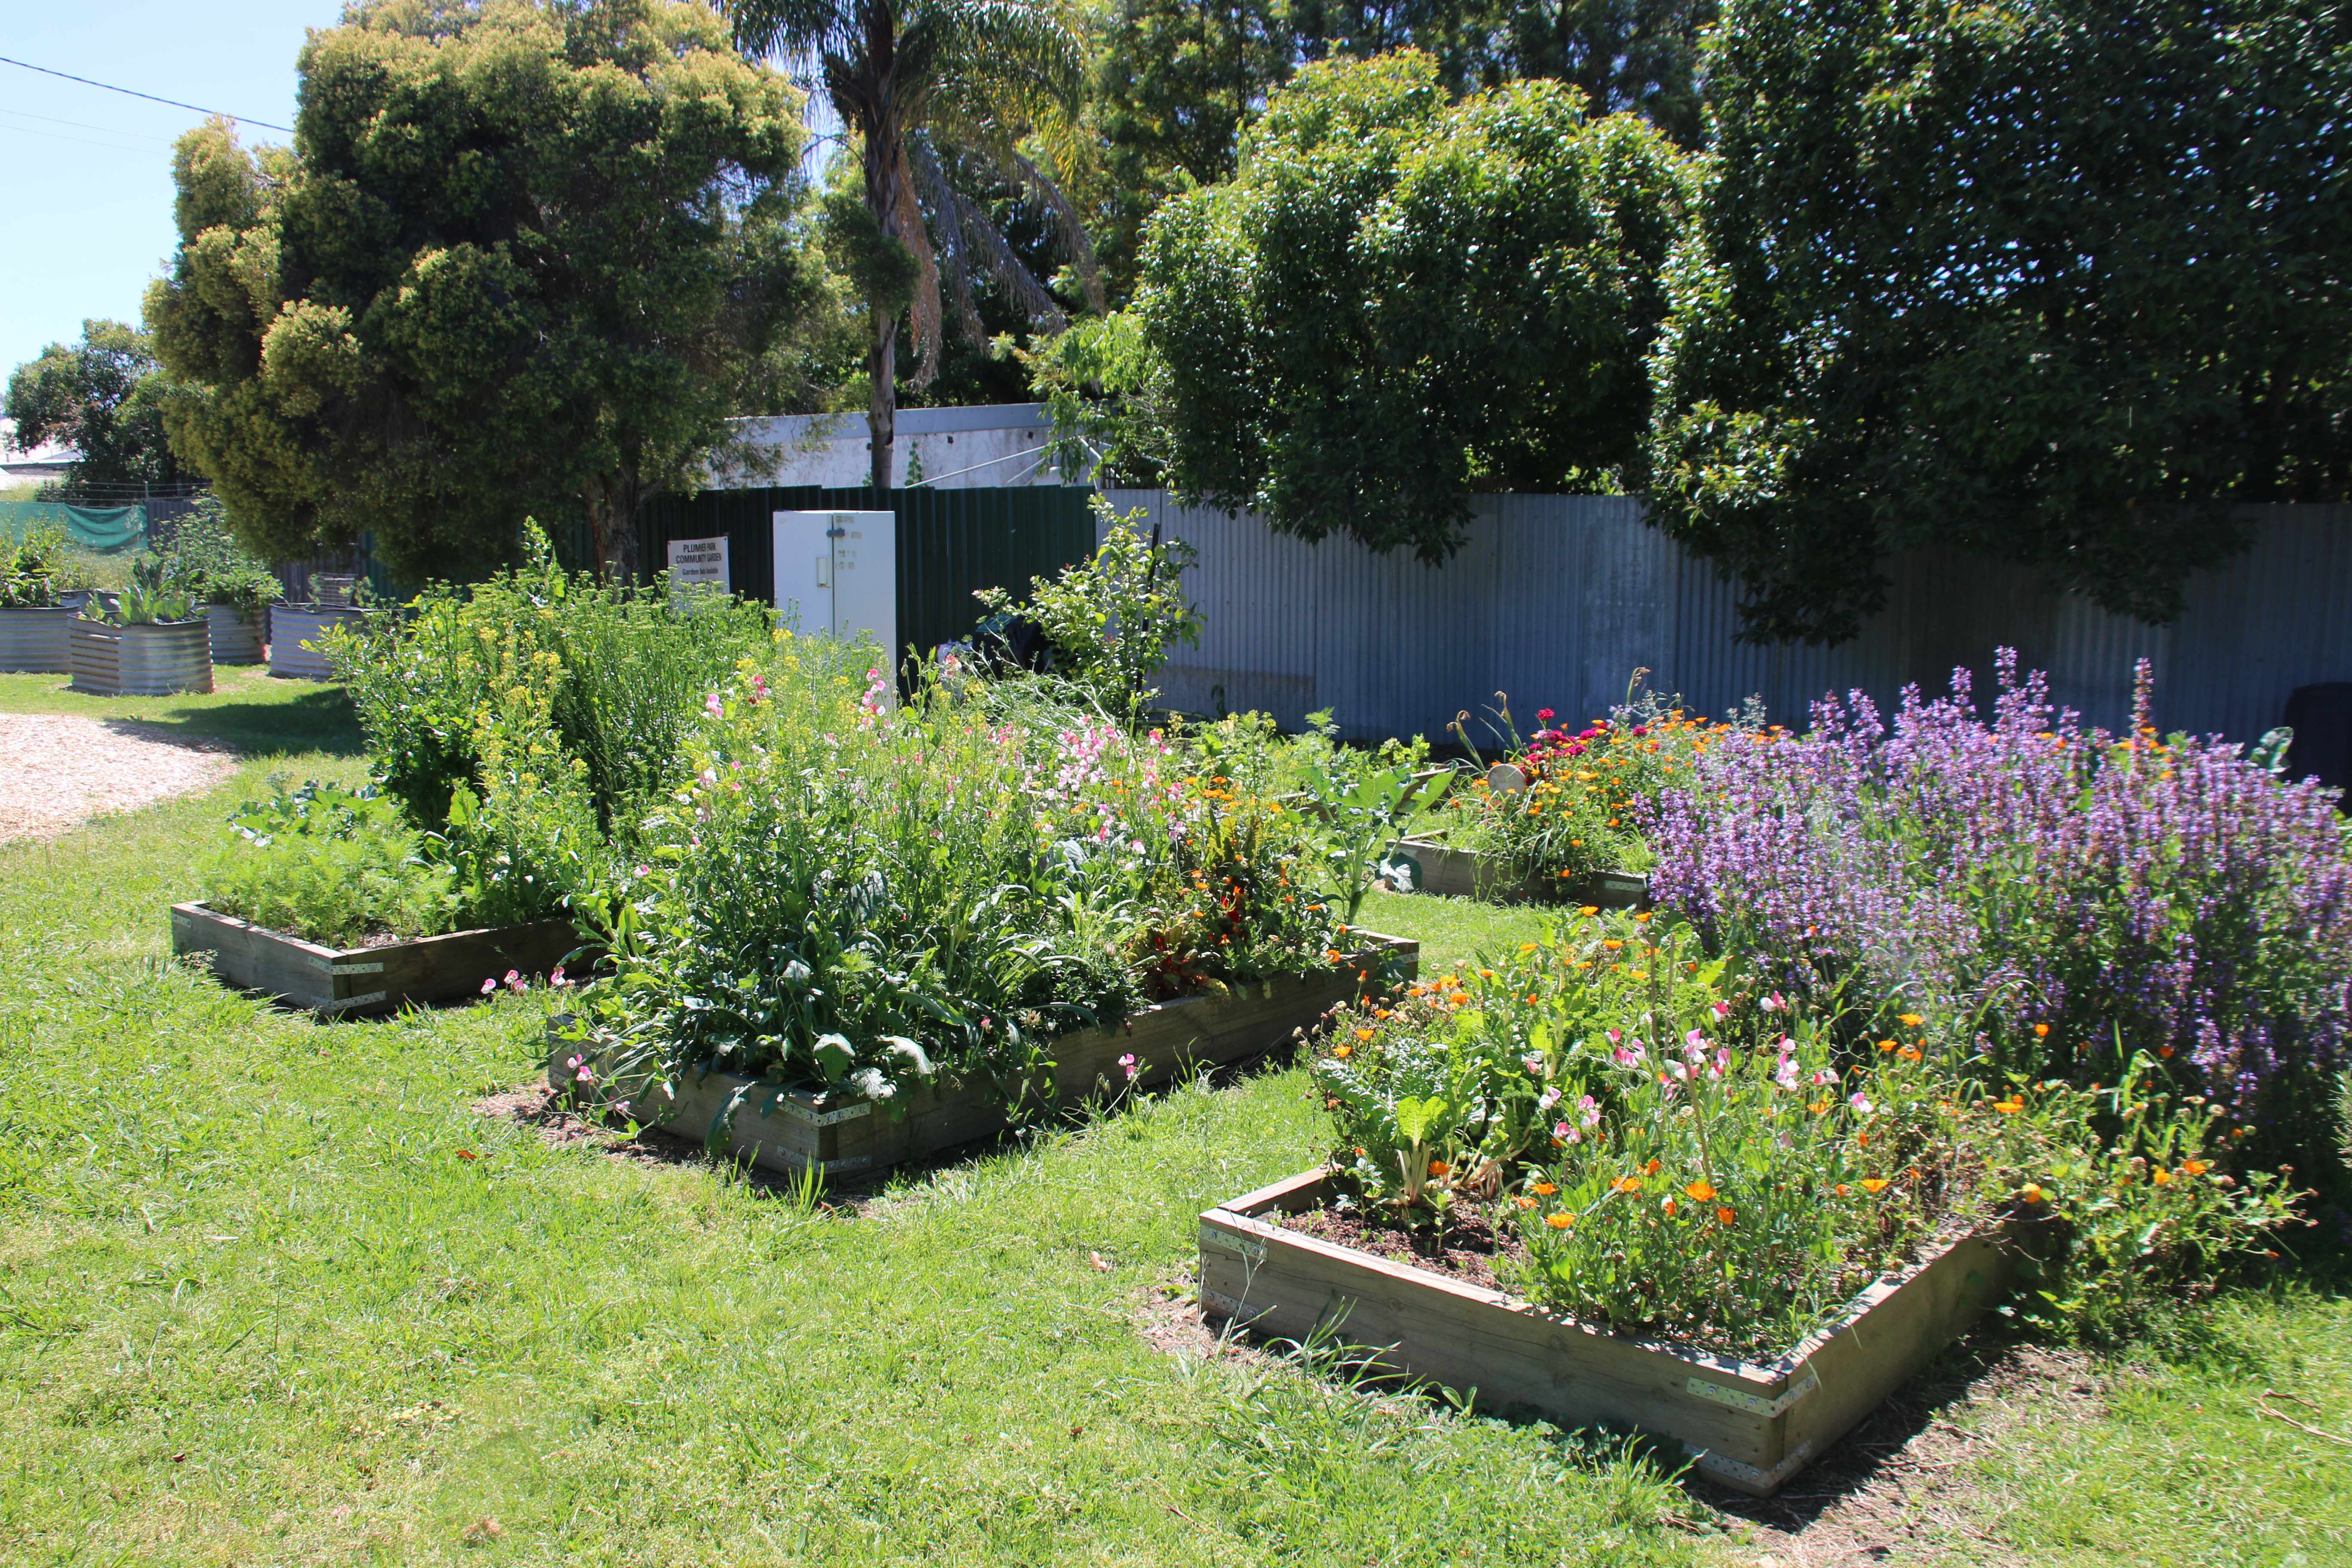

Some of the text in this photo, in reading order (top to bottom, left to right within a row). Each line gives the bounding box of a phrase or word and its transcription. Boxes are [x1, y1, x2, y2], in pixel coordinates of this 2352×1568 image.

[707, 542, 717, 551] PARK
[676, 553, 722, 564] COMMUNITY GARDEN
